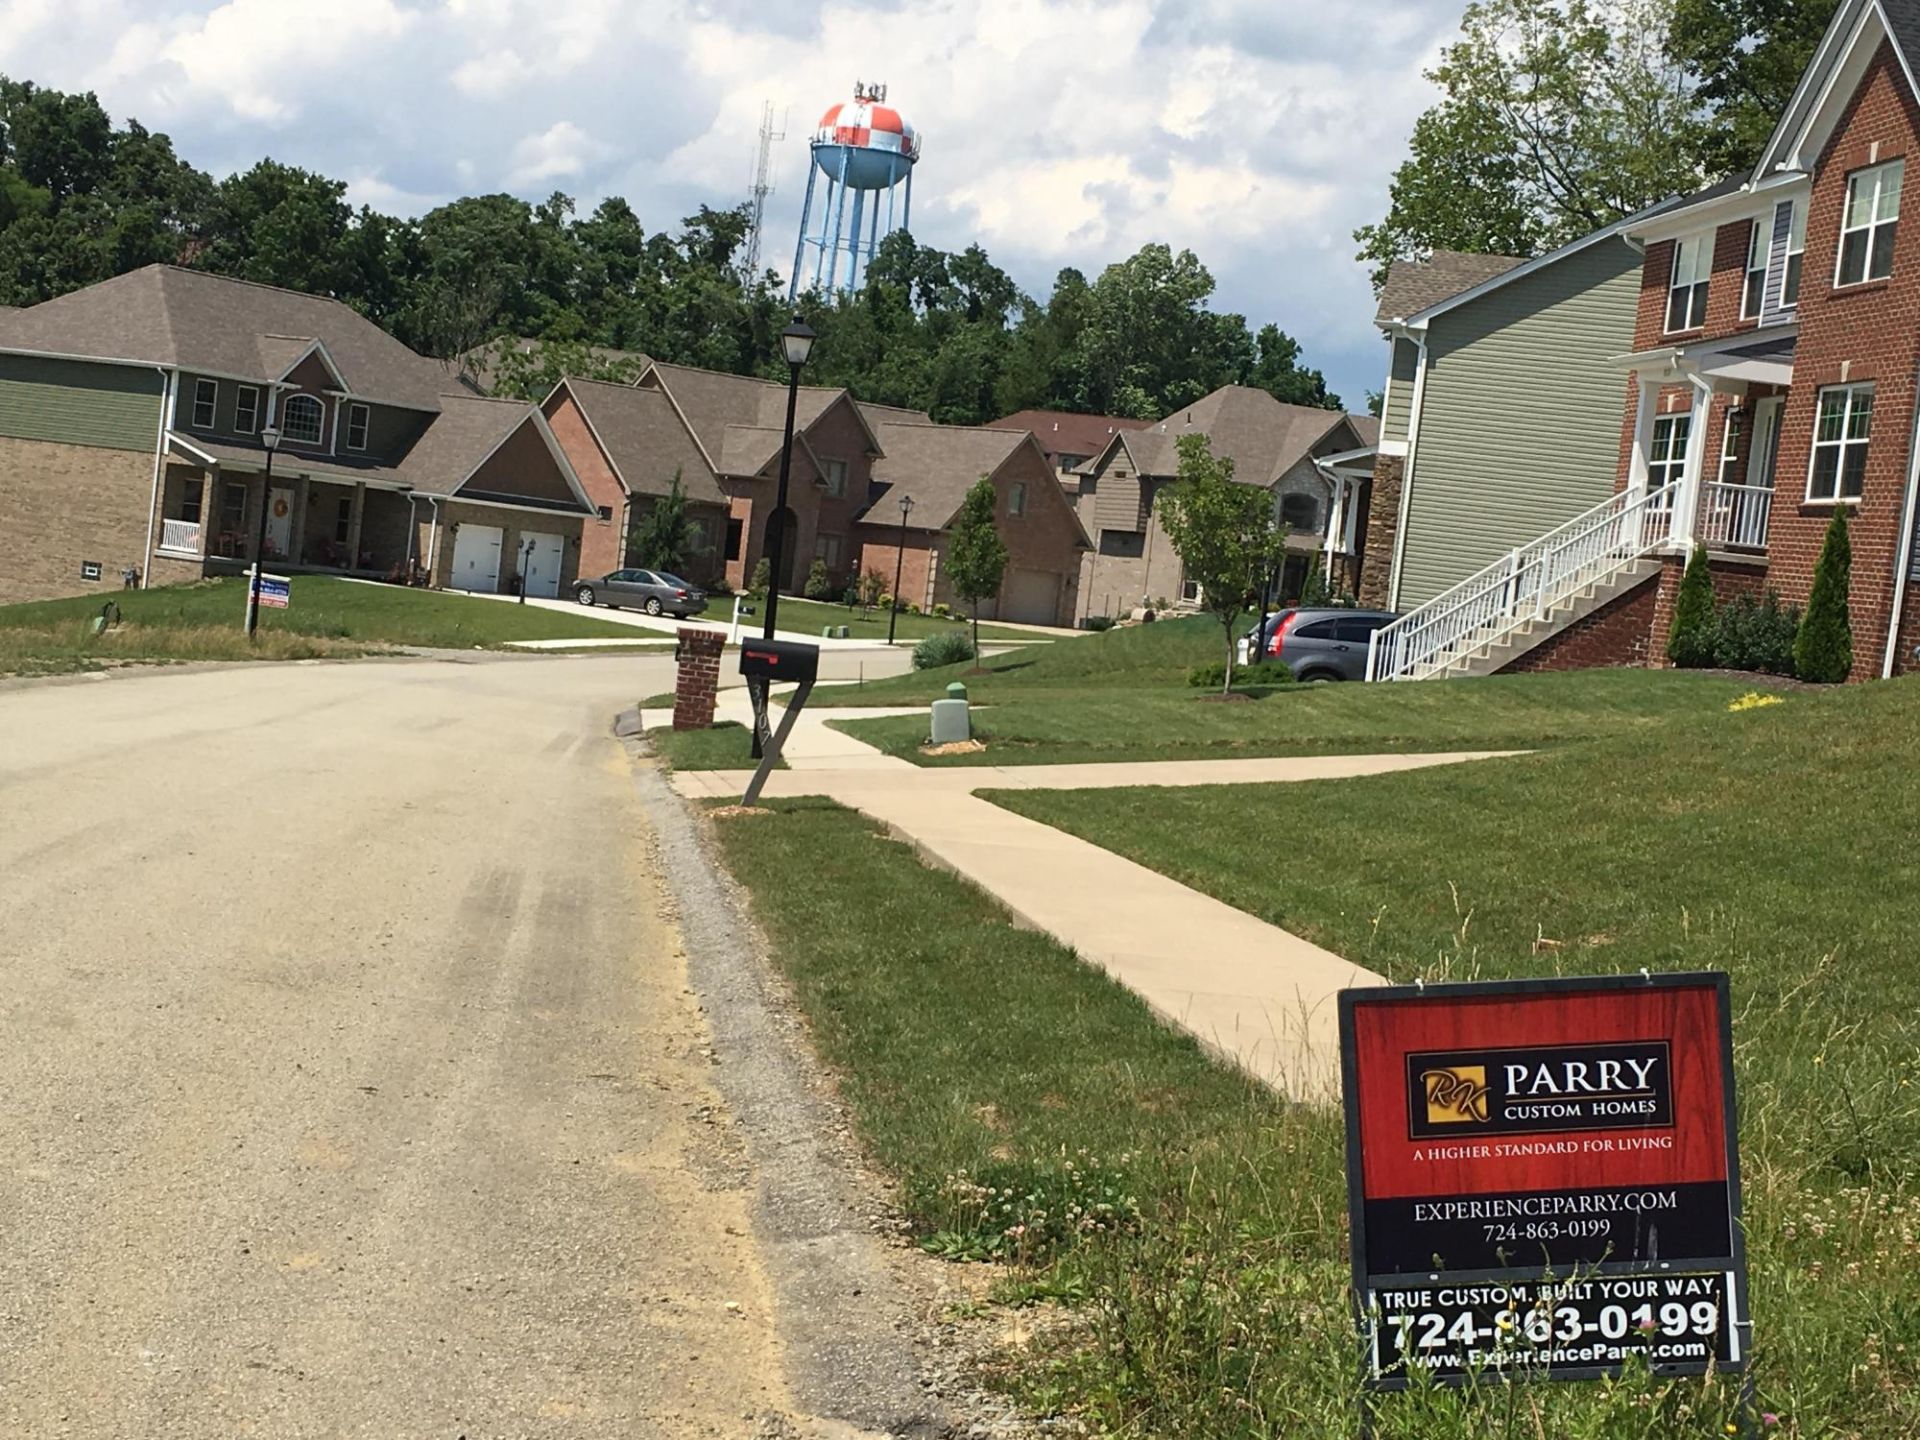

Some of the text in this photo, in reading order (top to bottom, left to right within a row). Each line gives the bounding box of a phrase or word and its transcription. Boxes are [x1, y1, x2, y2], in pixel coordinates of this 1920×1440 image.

[1503, 1057, 1658, 1096] PARRY
[1504, 1099, 1656, 1120] CUSTOM HOMES
[1413, 1136, 1672, 1161] A HIGHER STANDARD FOR LIVING
[1414, 1191, 1678, 1222] EXPERIENCEPARRY.COM
[1483, 1219, 1611, 1242] 724-863-0199
[1383, 1291, 1431, 1309] TRUE
[1438, 1286, 1533, 1306] CUSTOM.
[1541, 1283, 1593, 1301] BUILT
[1600, 1281, 1658, 1299] YOUR
[1387, 1301, 1717, 1349] 724-863-0199
[1404, 1342, 1706, 1369] wwwExerienceParry.com
